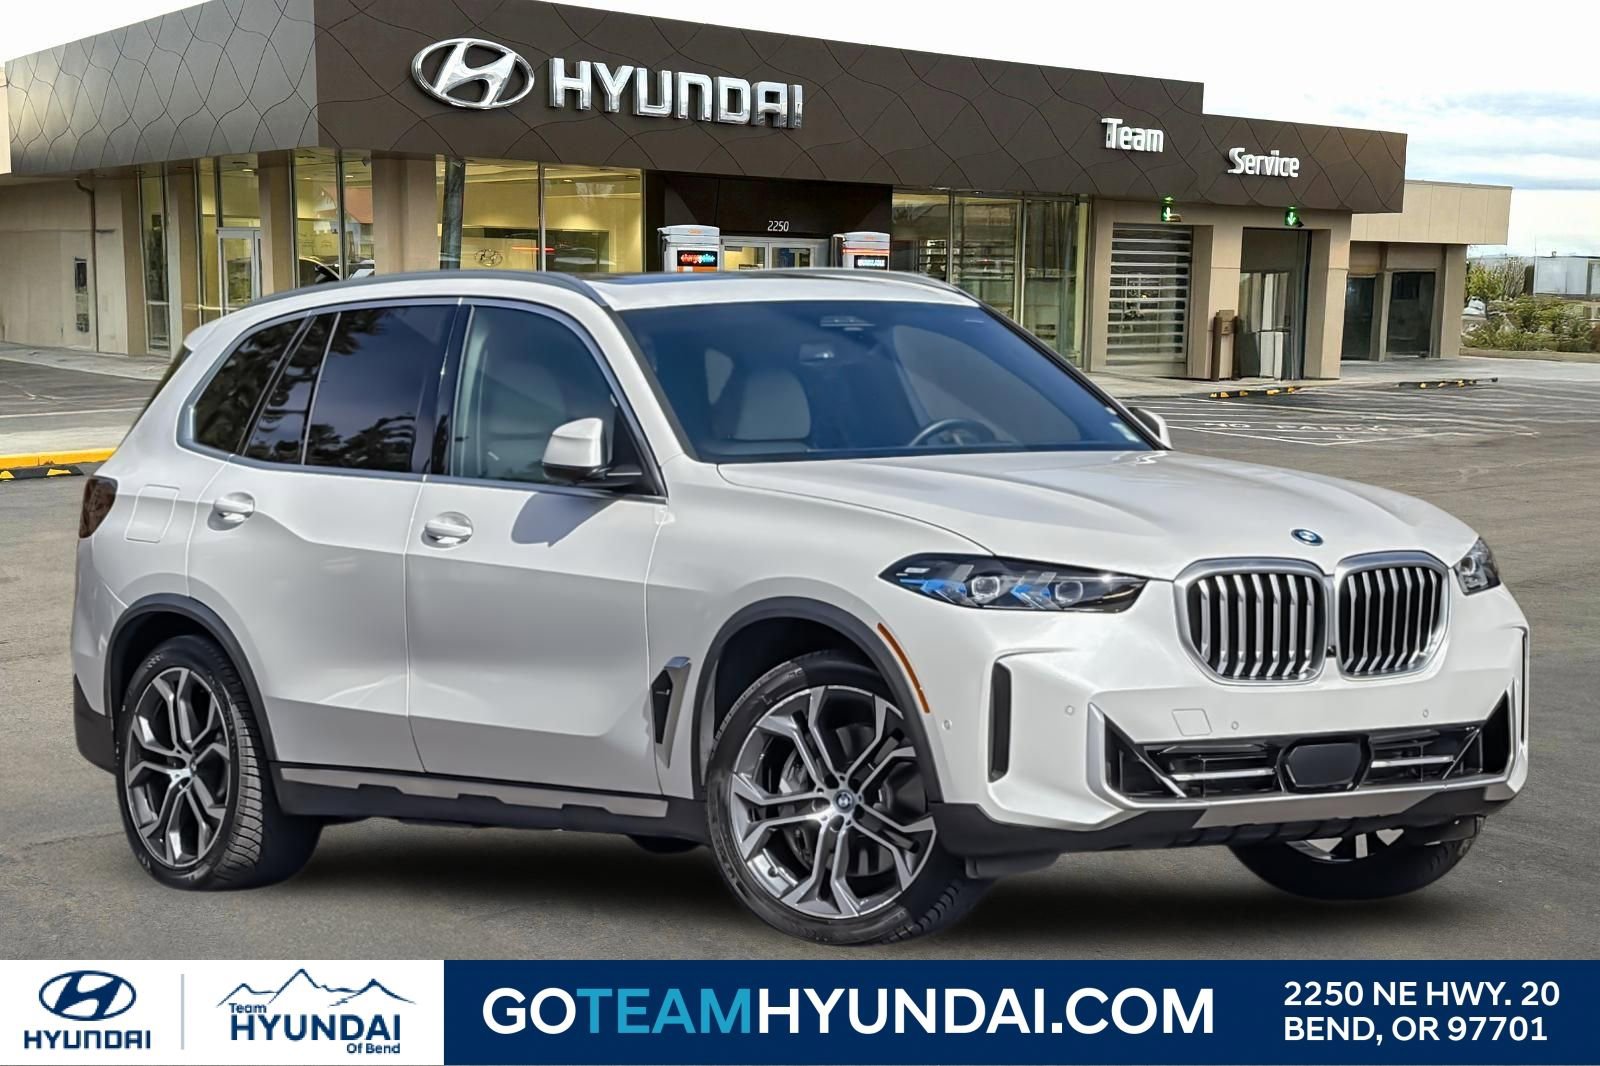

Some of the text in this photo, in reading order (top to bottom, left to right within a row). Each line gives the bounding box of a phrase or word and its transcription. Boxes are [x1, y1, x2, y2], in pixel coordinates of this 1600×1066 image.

[548, 57, 803, 129] HYUNDAI
[1101, 117, 1164, 152] Team
[1227, 147, 1300, 178] Service
[767, 220, 790, 232] 2250
